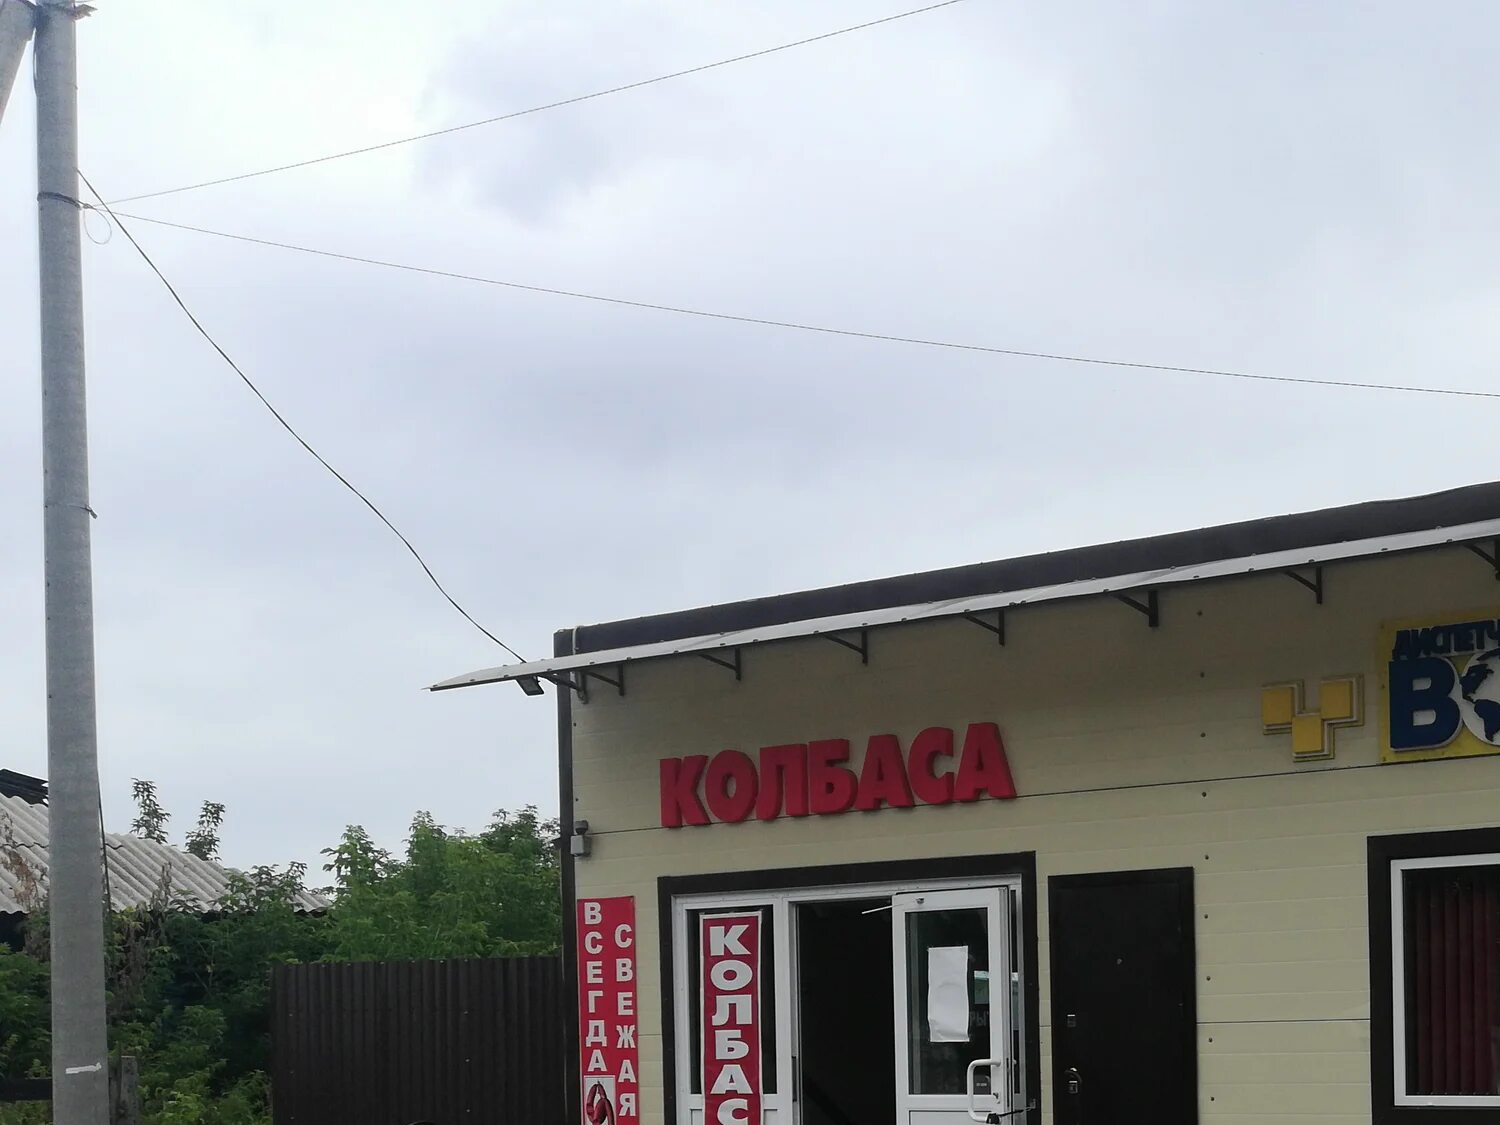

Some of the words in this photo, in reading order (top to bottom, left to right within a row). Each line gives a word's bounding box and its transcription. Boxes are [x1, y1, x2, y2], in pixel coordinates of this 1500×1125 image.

[660, 722, 1017, 828] КОЛБАСА
[584, 902, 607, 1072] ВСЕГДА
[614, 923, 637, 1117] СВЕЖАЯ
